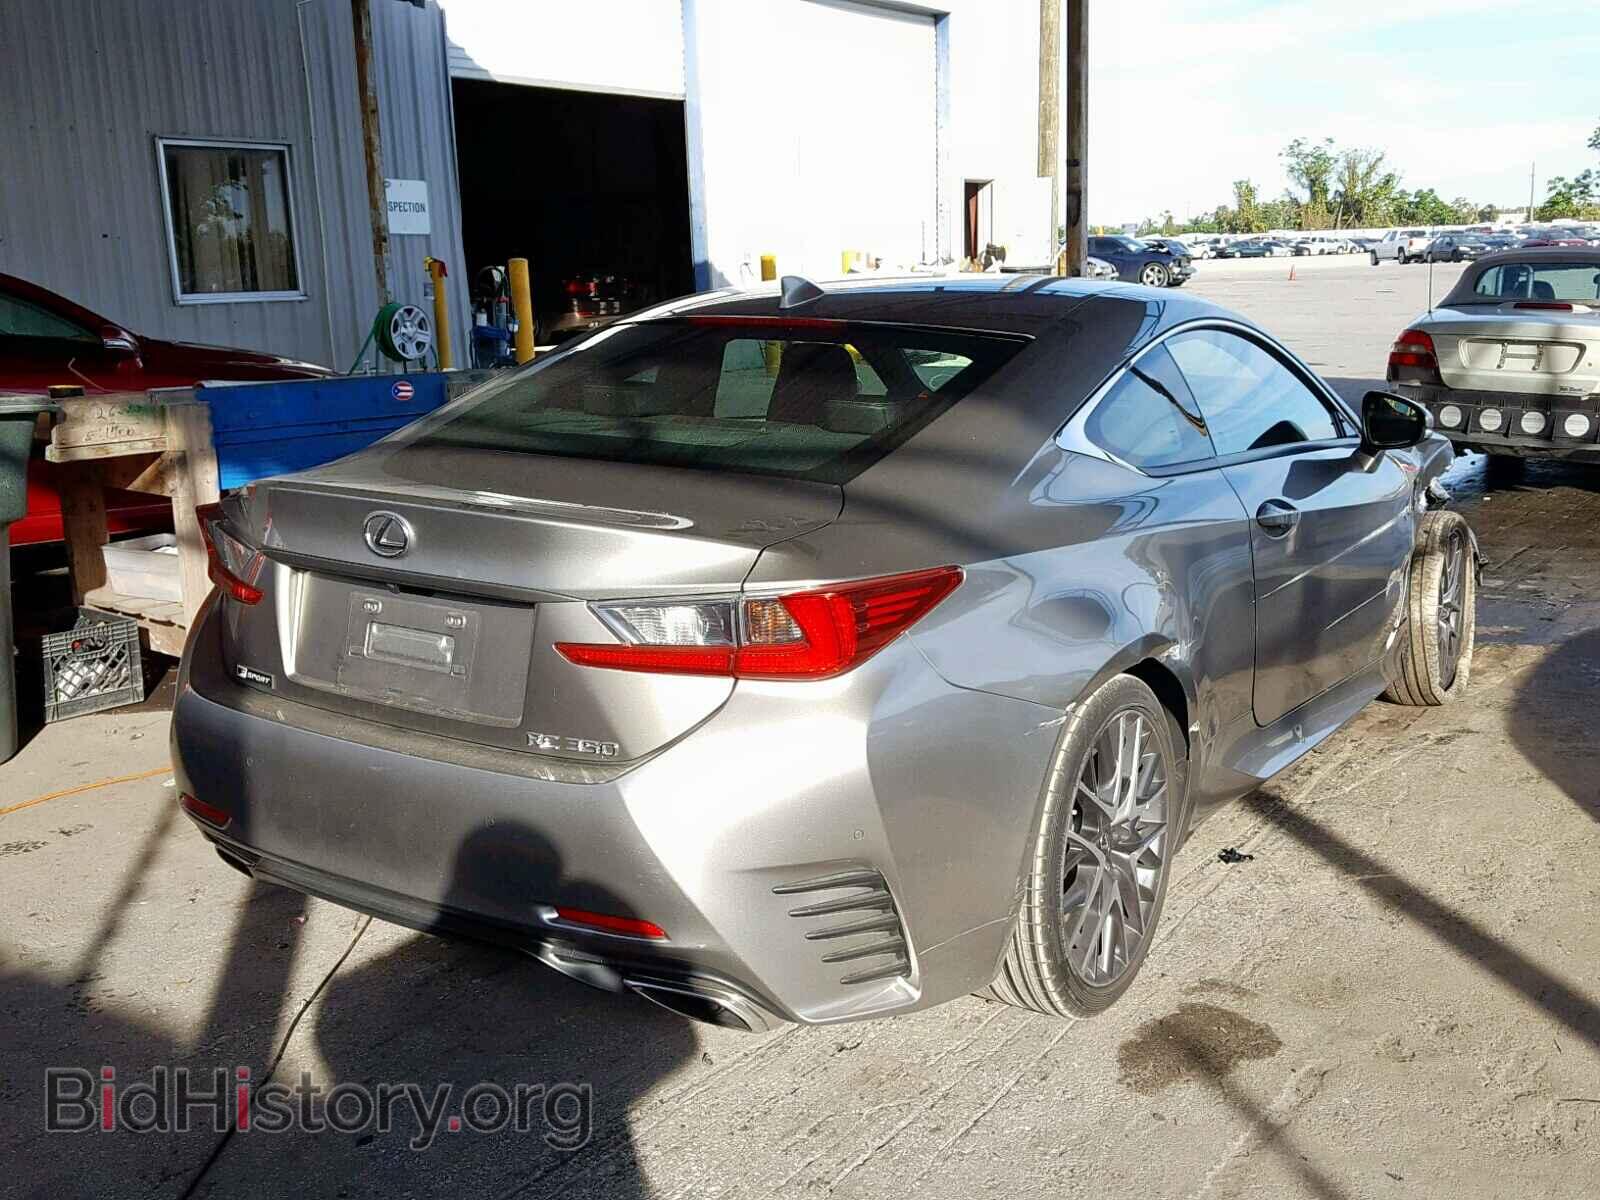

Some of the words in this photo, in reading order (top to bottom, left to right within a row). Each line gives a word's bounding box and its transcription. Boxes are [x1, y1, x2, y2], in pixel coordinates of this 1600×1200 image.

[388, 201, 426, 213] SPECTION
[247, 671, 271, 684] SPORT
[527, 731, 560, 750] RC
[564, 737, 618, 757] 350
